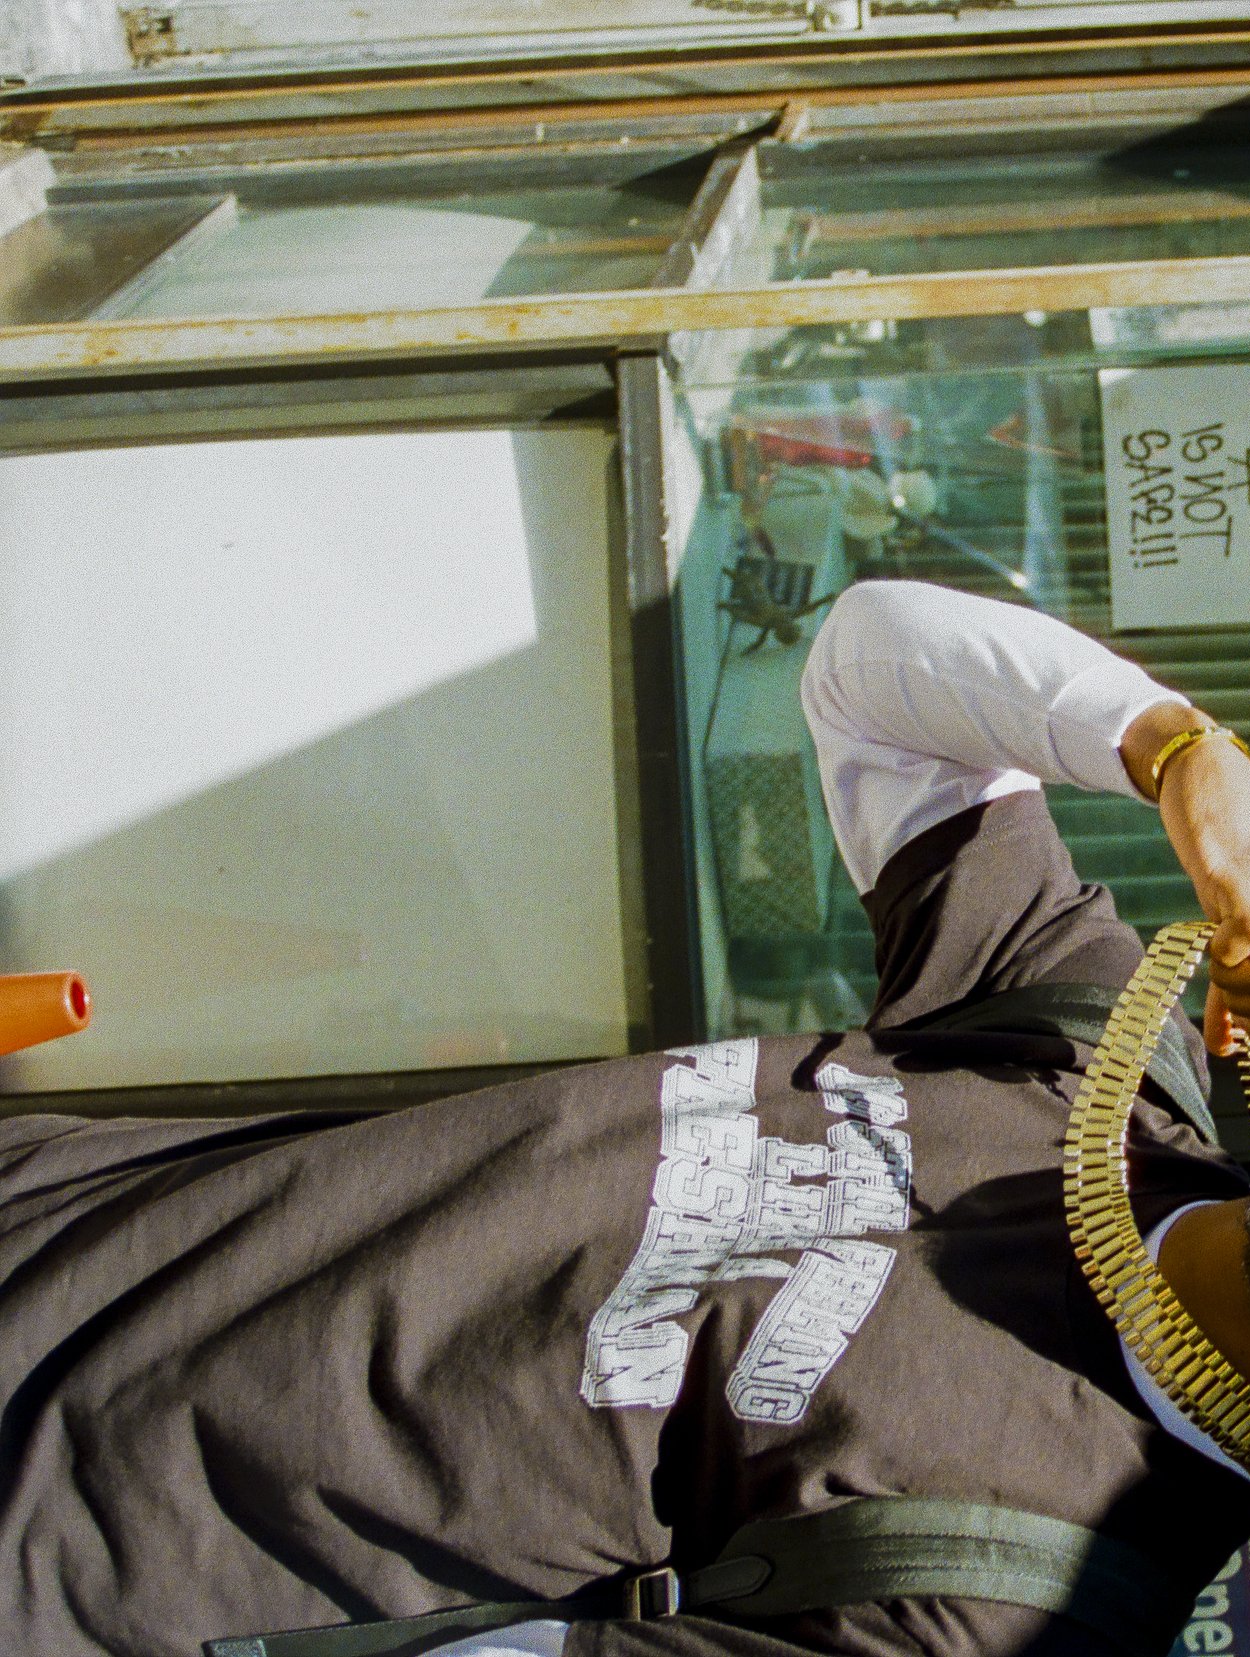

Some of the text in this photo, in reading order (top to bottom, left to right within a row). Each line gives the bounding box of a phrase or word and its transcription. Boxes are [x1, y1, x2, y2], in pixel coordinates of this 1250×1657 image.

[1121, 430, 1179, 570] SAFE!!!
[1178, 422, 1233, 557] IS NOT
[579, 1036, 759, 1409] FRESHMAN
[726, 1238, 898, 1425] FEELING
